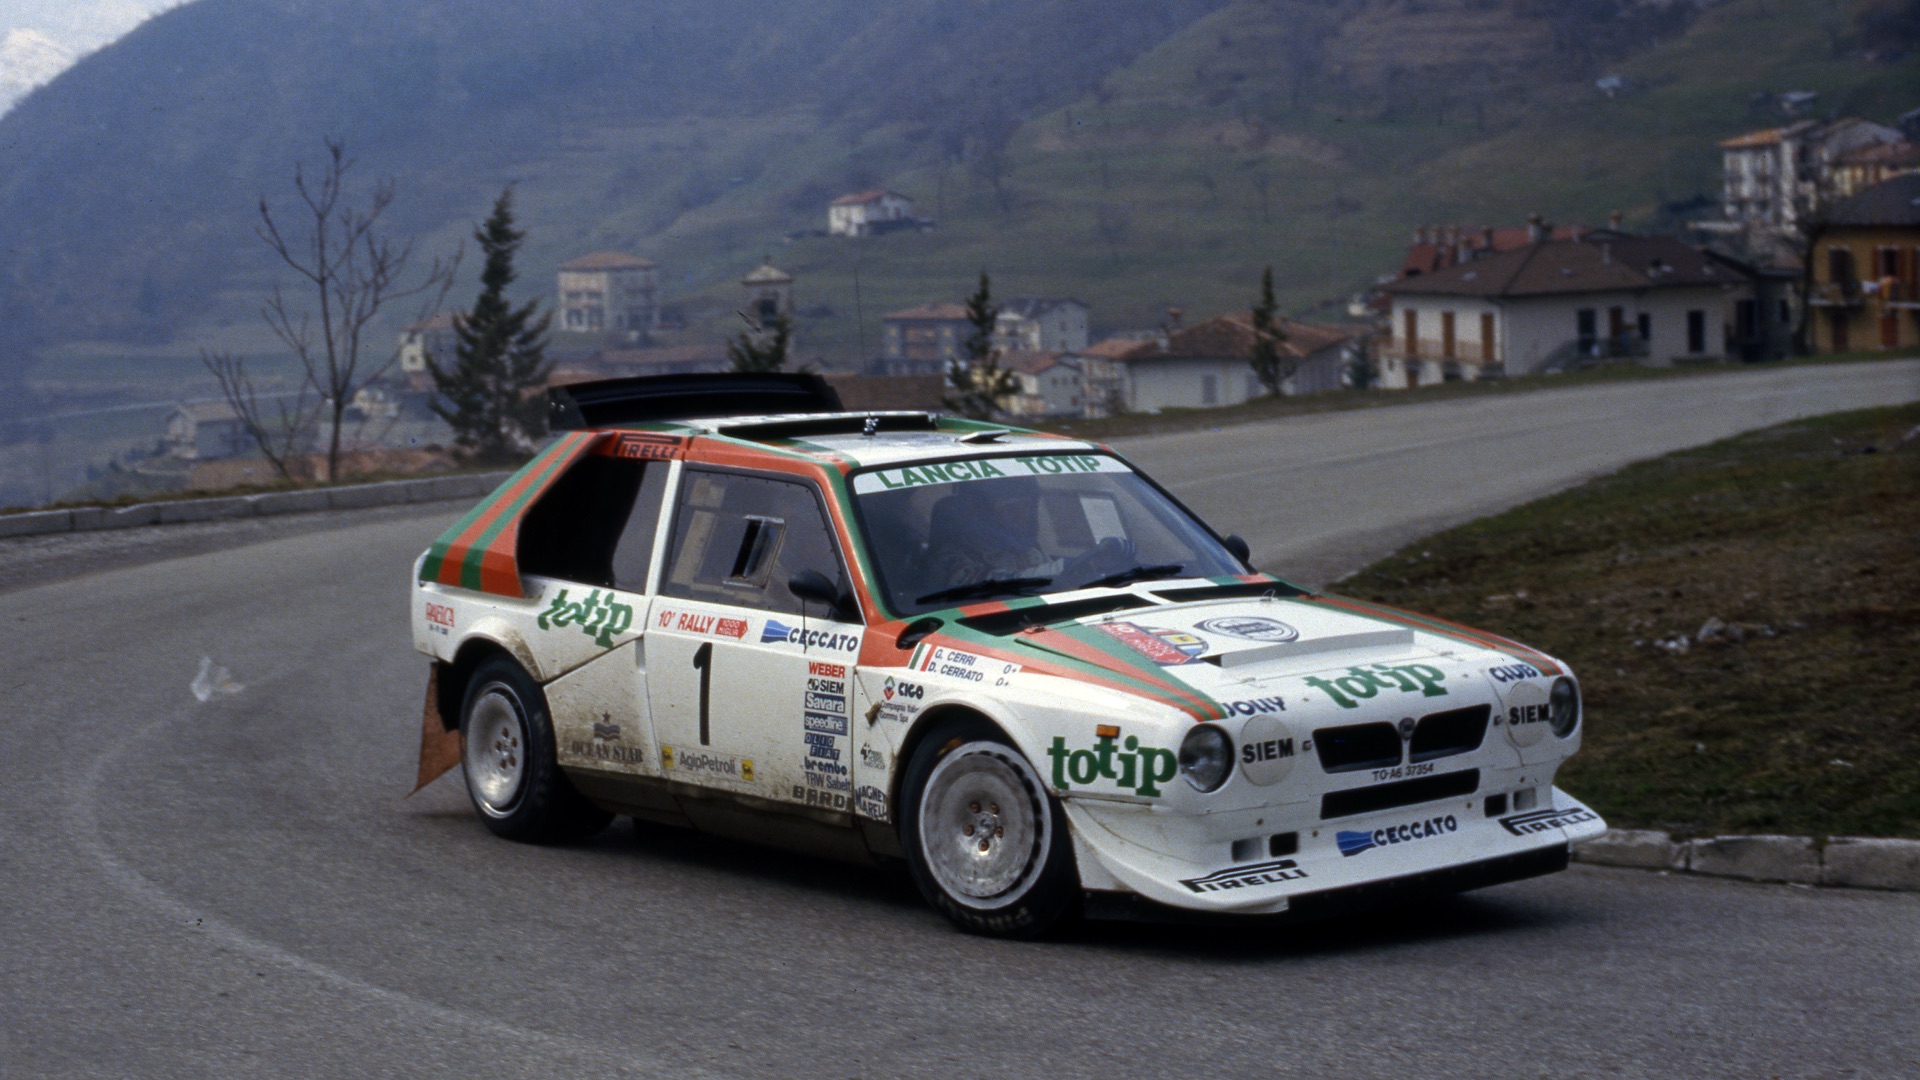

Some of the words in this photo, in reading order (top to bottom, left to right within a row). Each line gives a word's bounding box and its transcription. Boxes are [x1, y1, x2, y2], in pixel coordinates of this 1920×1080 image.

[876, 459, 1005, 489] LANCIA
[1015, 455, 1101, 475] TOTIP
[538, 589, 633, 649] totip
[678, 613, 715, 634] RALLY
[789, 628, 859, 653] CECCATO
[808, 661, 846, 679] WEBER
[935, 650, 943, 660] G.
[947, 651, 977, 667] CERRI
[928, 661, 937, 673] D.
[940, 664, 984, 683] CERRATO
[693, 642, 713, 746] 1
[820, 679, 845, 695] SIEM
[1223, 696, 1287, 718] JOLLY
[1303, 664, 1448, 709] totip
[1489, 664, 1538, 683] CLUB
[805, 693, 844, 713] Savara
[1509, 703, 1550, 726] SIEM
[804, 715, 843, 732] speedline
[571, 740, 610, 758] OCEAN
[613, 747, 644, 763] STAR
[805, 733, 834, 747] OLIO
[1242, 738, 1294, 764] SIEM
[680, 751, 736, 775] AgipPetroli
[811, 746, 840, 760] FIAT
[804, 756, 848, 776] brembo
[1047, 735, 1177, 798] totip
[804, 771, 825, 787] TRW
[1373, 814, 1458, 847] CECCATO
[1498, 807, 1599, 837] PIRELLI
[1178, 859, 1309, 894] PIRELLI
